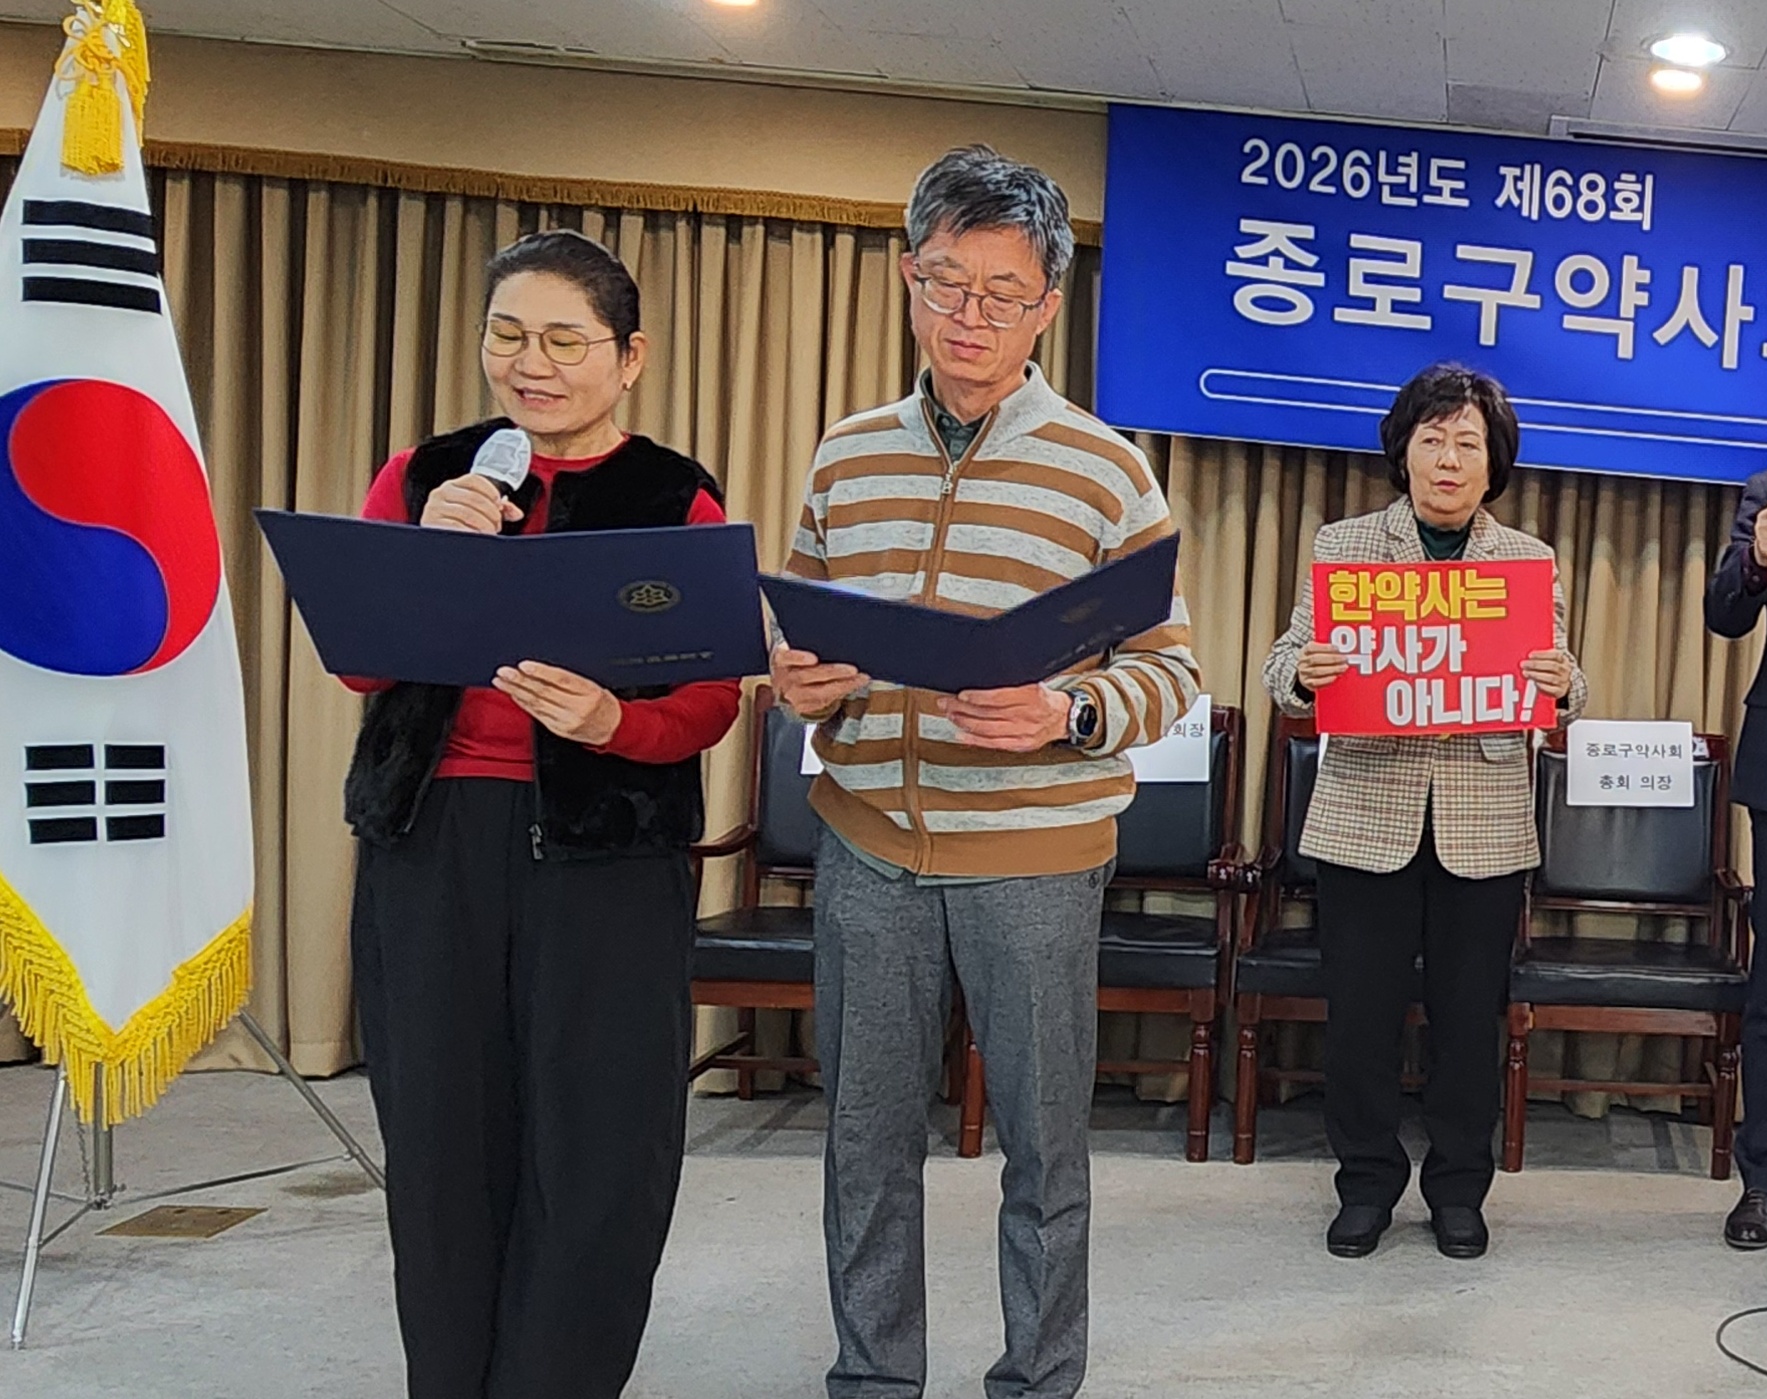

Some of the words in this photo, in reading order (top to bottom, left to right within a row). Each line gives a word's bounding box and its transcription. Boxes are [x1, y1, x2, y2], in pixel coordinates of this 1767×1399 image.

[1240, 137, 1471, 210] 2026년도
[1494, 162, 1656, 230] 제68회
[1328, 569, 1507, 621] 한약사는
[1330, 623, 1468, 674] 약사가
[1385, 674, 1537, 727] 아니다!
[1586, 742, 1682, 759] 종로구약사회
[1599, 774, 1630, 790] 총회
[1640, 775, 1672, 791] 의장
